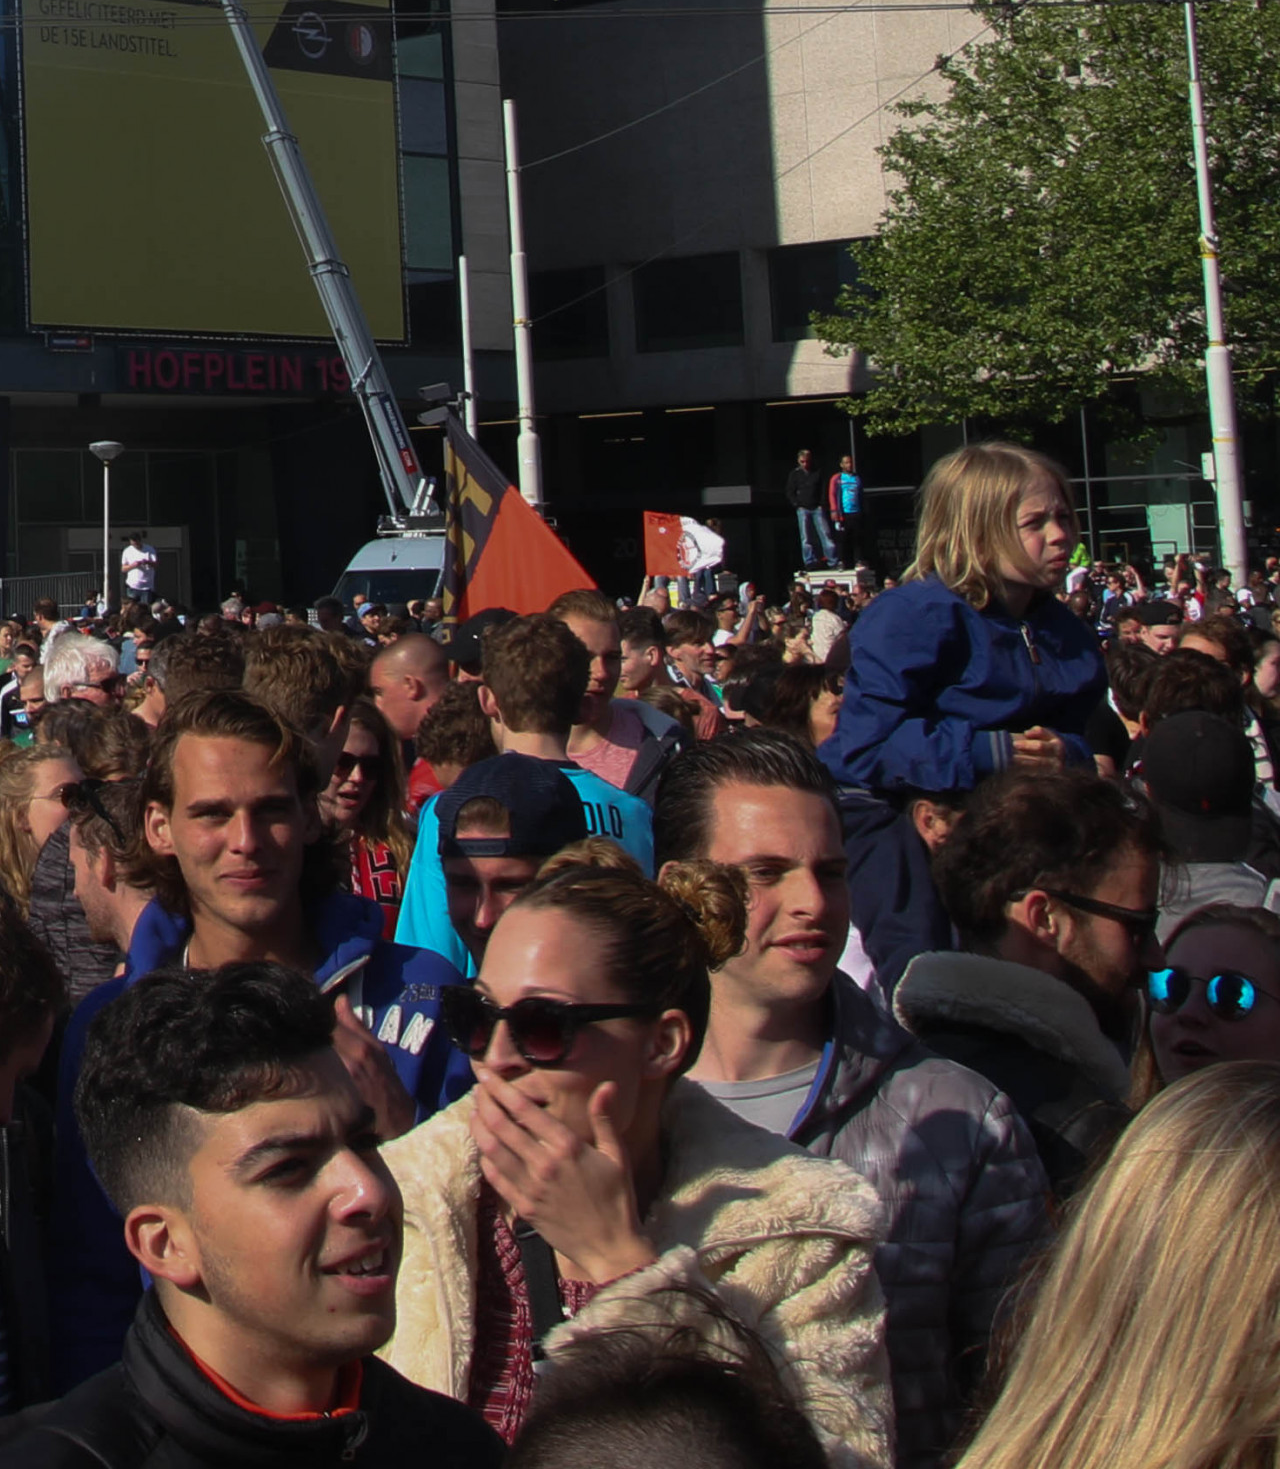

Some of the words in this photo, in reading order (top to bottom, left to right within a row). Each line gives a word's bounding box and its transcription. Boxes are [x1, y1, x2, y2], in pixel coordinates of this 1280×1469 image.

[41, 26, 59, 44] DE
[64, 29, 87, 48] 15E
[128, 351, 304, 391] HOFPLEIN
[316, 357, 351, 392] 19
